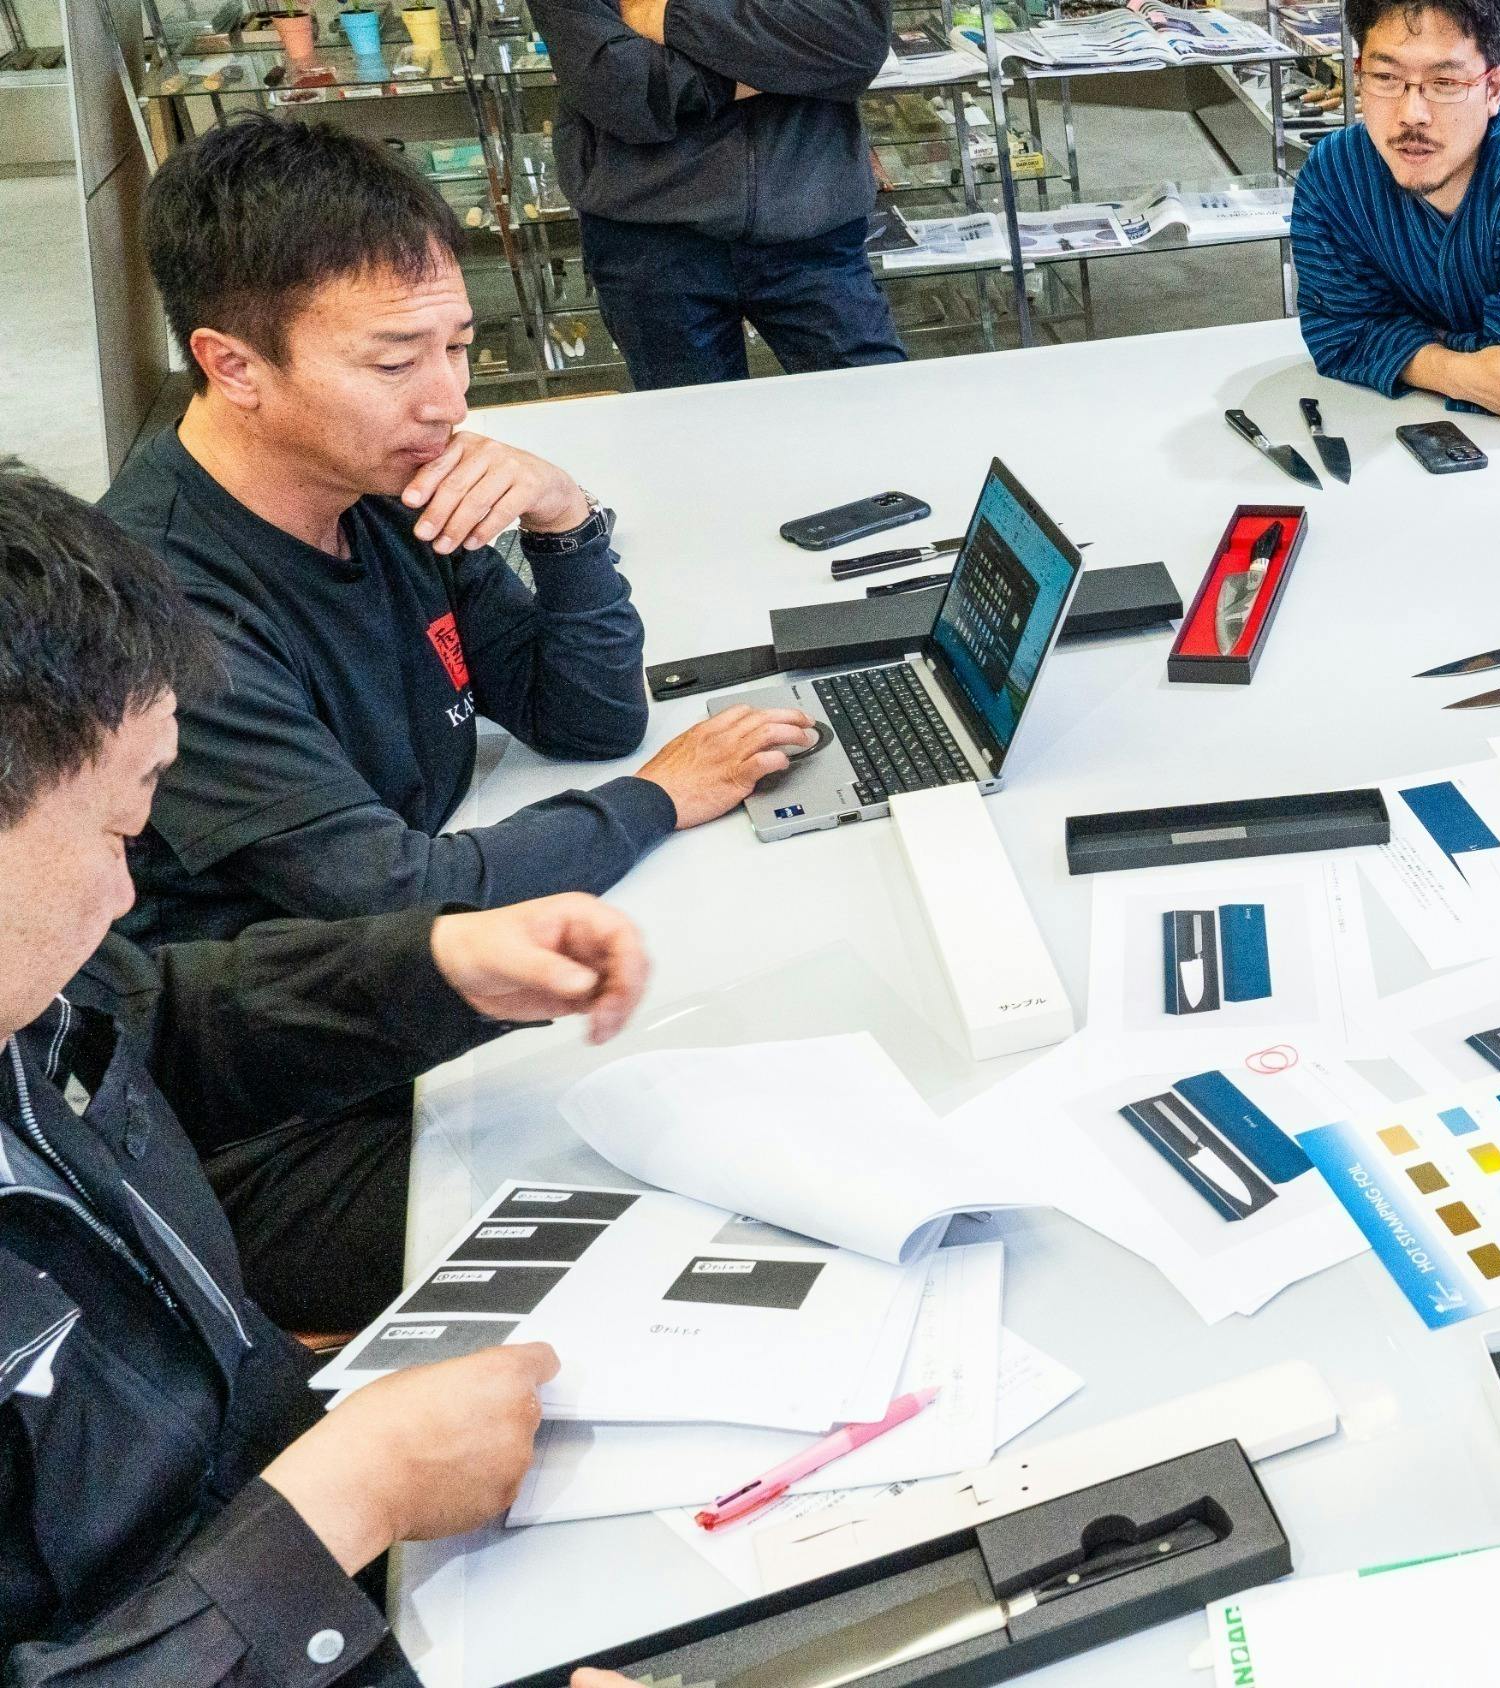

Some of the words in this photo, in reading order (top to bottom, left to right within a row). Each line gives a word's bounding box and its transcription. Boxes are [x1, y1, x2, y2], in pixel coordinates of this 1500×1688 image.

[1348, 1162, 1374, 1189] FOIL
[1365, 1188, 1416, 1248] STAMPING
[1406, 1247, 1436, 1274] HOT
